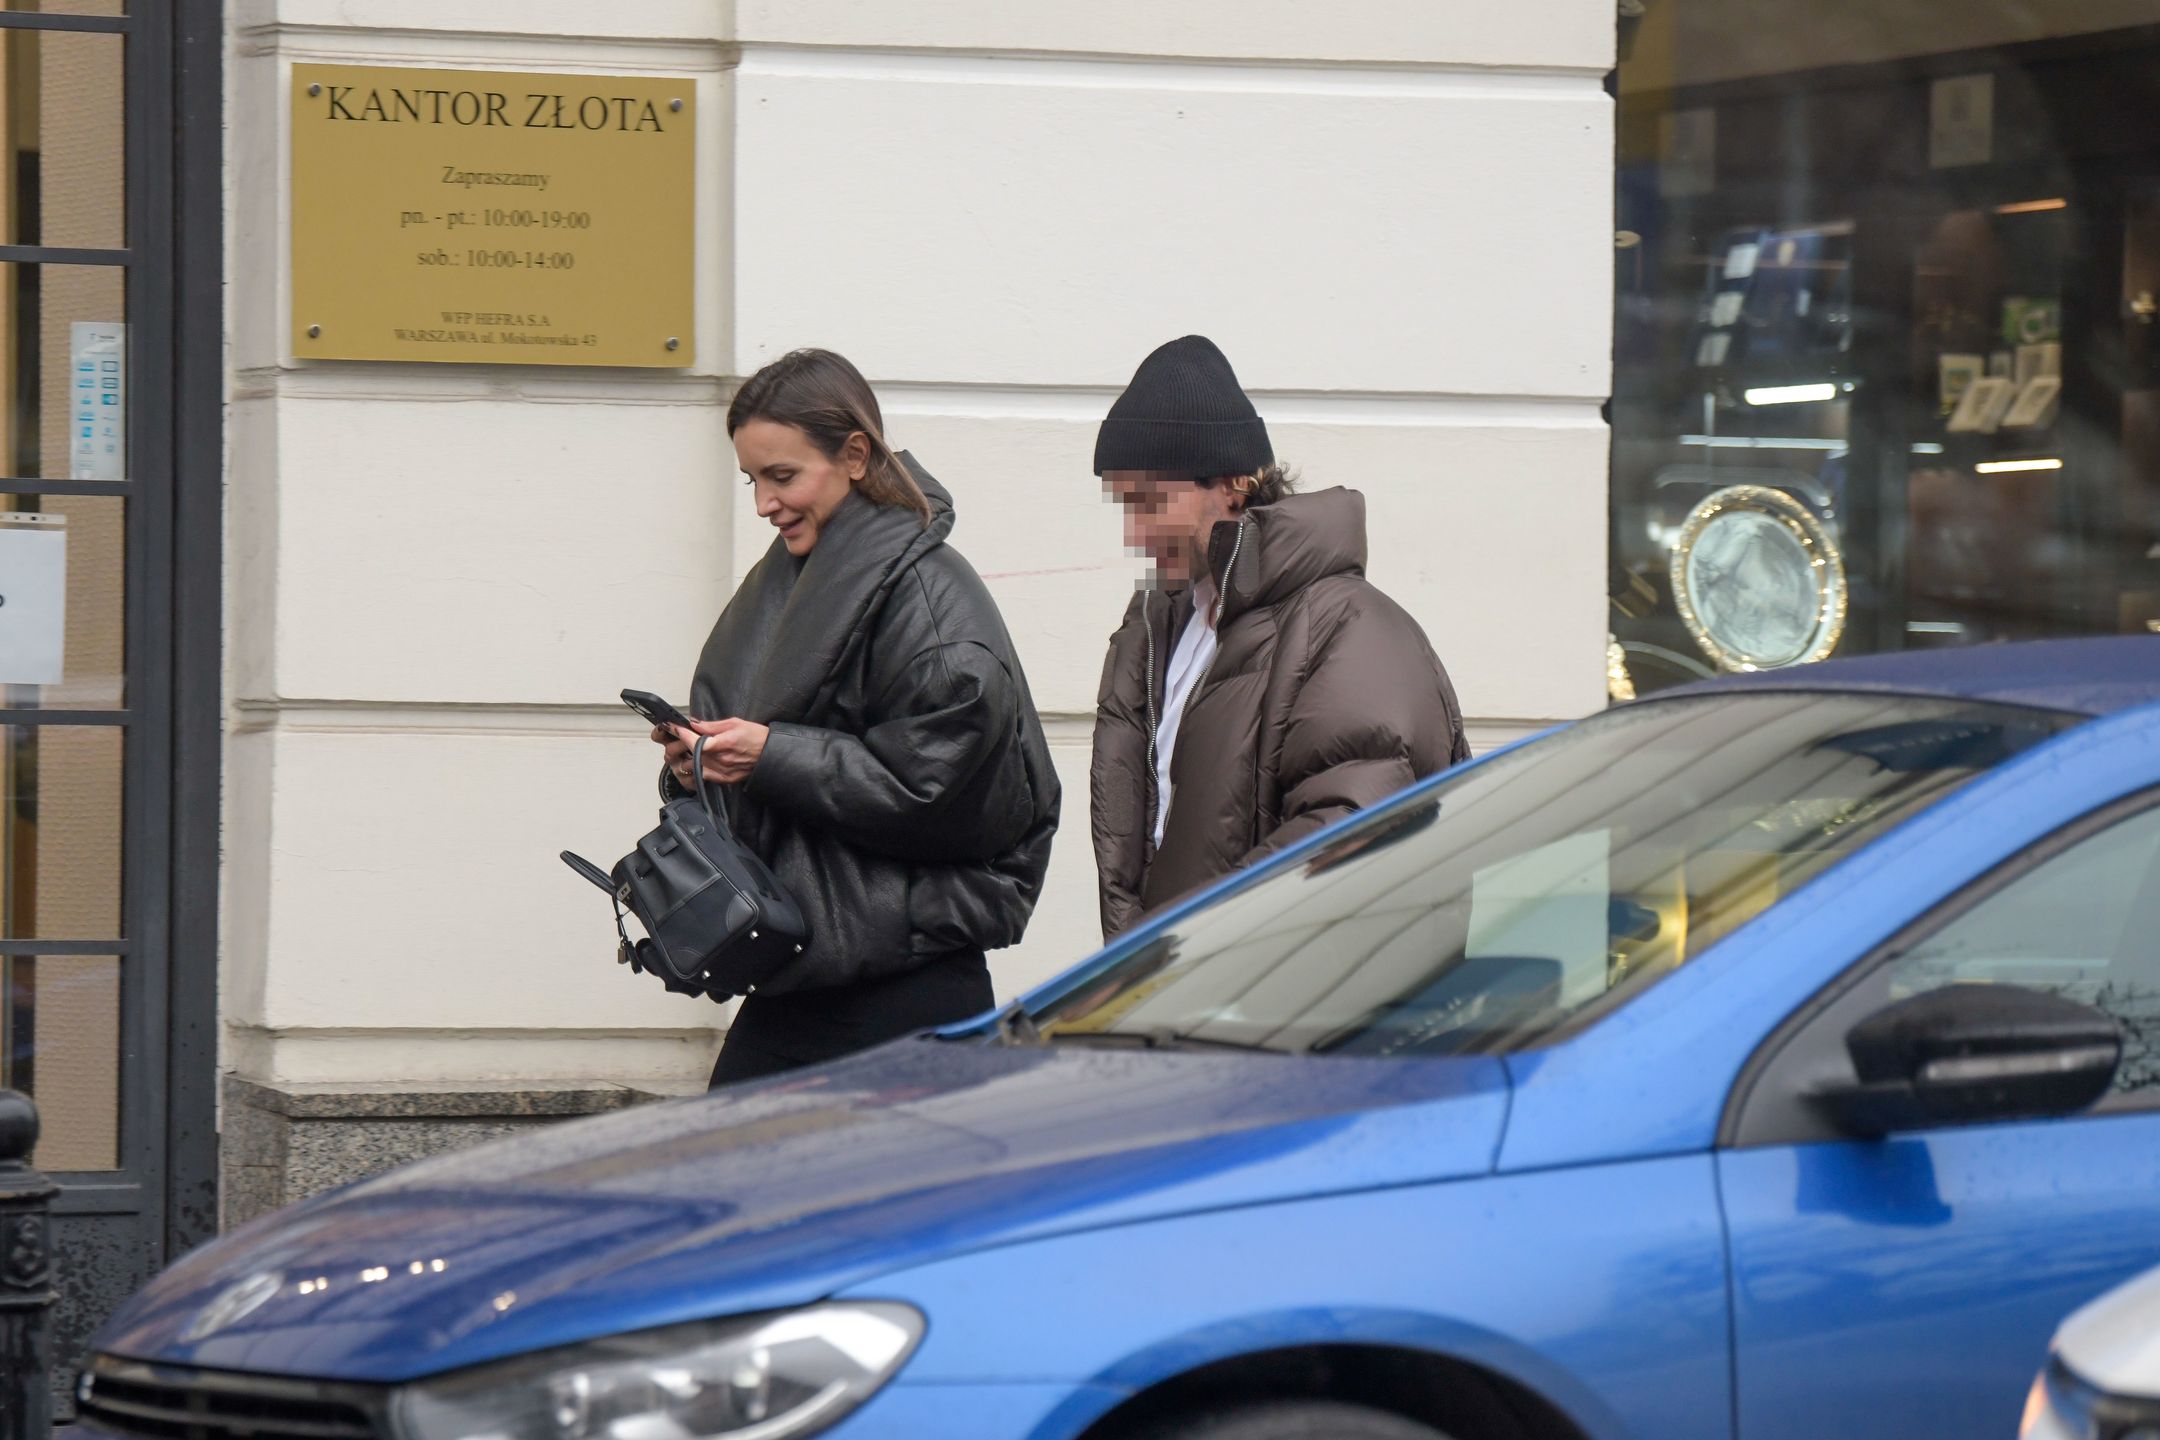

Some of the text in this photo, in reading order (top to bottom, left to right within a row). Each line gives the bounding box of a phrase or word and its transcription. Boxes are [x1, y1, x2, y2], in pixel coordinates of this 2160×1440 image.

[326, 85, 665, 132] KANTOR ZŁOTA
[441, 165, 551, 191] Zapraszamy
[400, 211, 429, 228] pn.
[483, 209, 591, 229] 10:00-19:00
[417, 248, 575, 270] sob.: 10:00-14:00
[475, 312, 525, 326] HEFRA
[393, 328, 480, 343] WARSZAWA
[501, 332, 580, 346] Mokotowska
